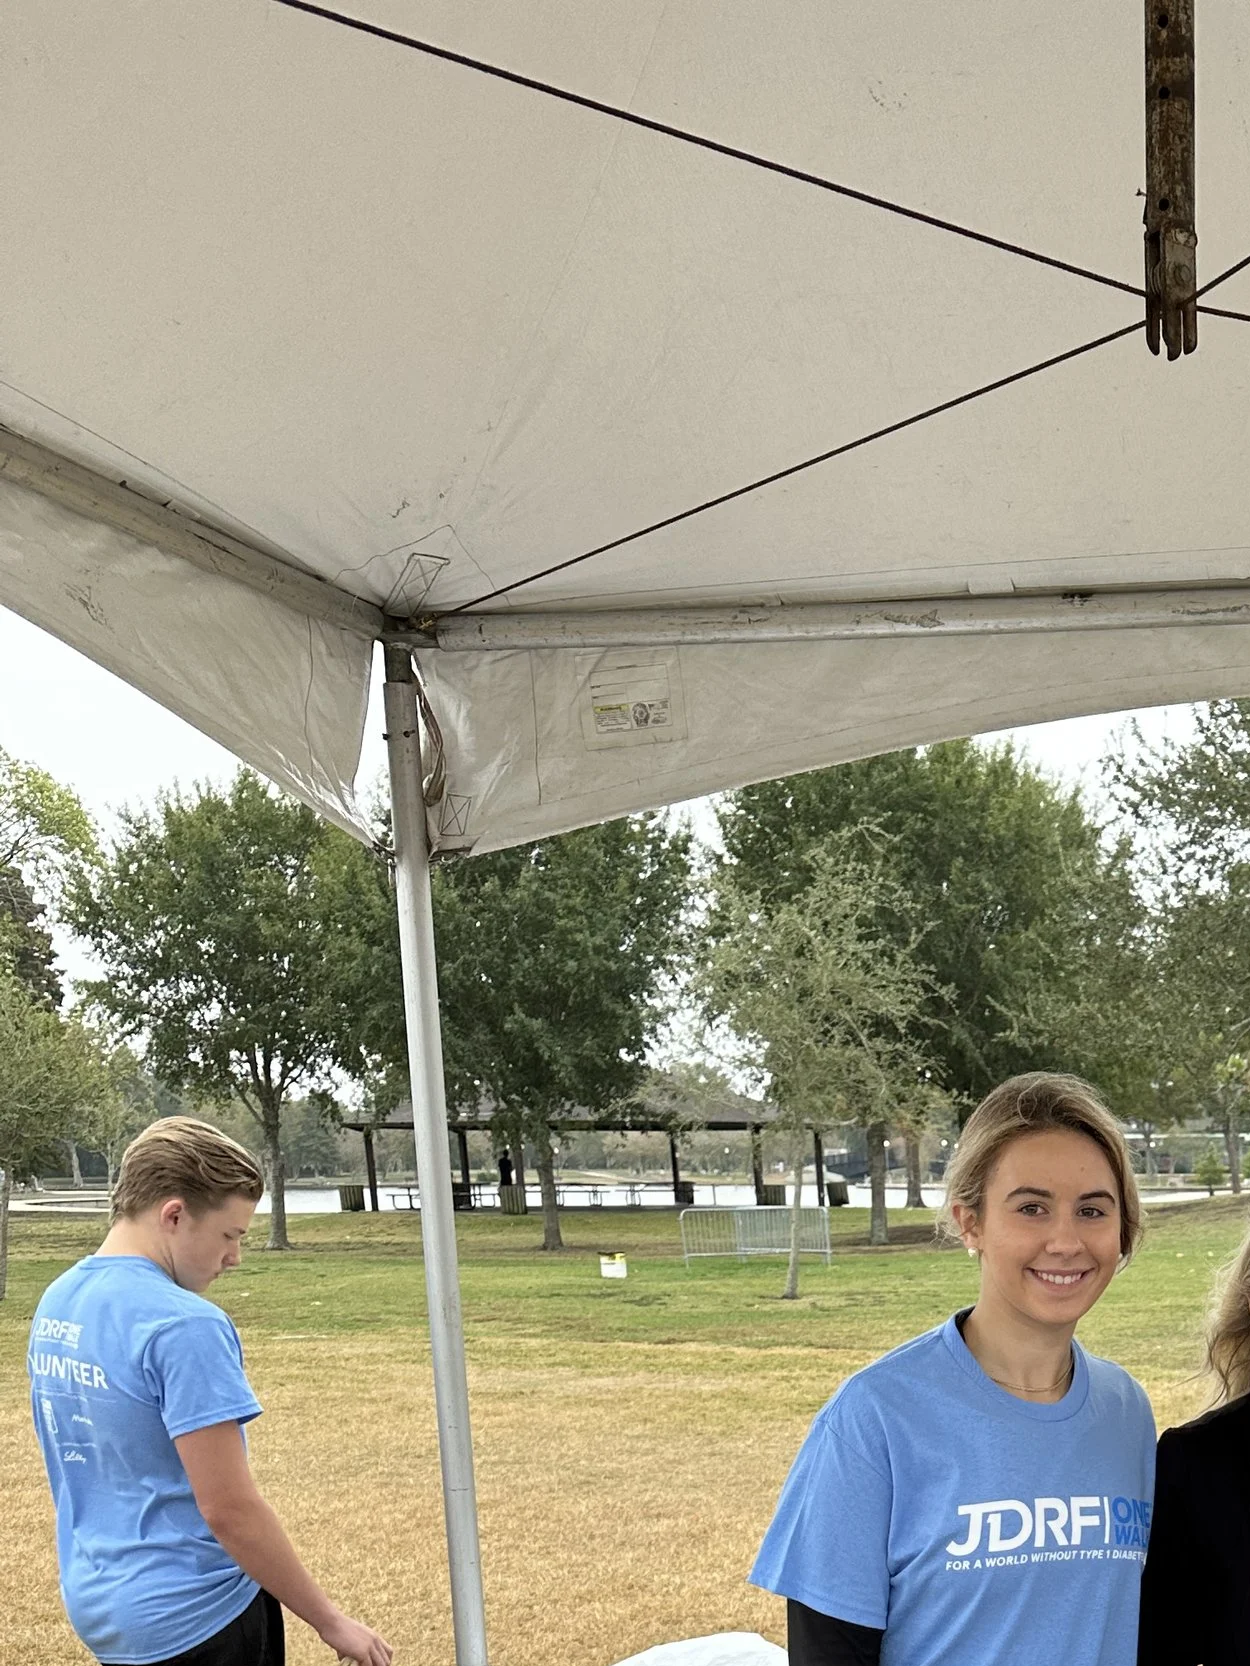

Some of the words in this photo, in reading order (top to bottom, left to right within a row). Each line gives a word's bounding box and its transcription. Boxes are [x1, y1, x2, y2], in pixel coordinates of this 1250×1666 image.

[945, 1496, 1101, 1557] JDRF
[1114, 1524, 1148, 1548] WAL
[945, 1560, 970, 1571] FOR
[973, 1559, 982, 1569] A
[984, 1555, 1028, 1567] WORLD
[1030, 1551, 1076, 1563] WITHOUT
[1079, 1549, 1104, 1560] TYPE
[1105, 1549, 1111, 1559] 1
